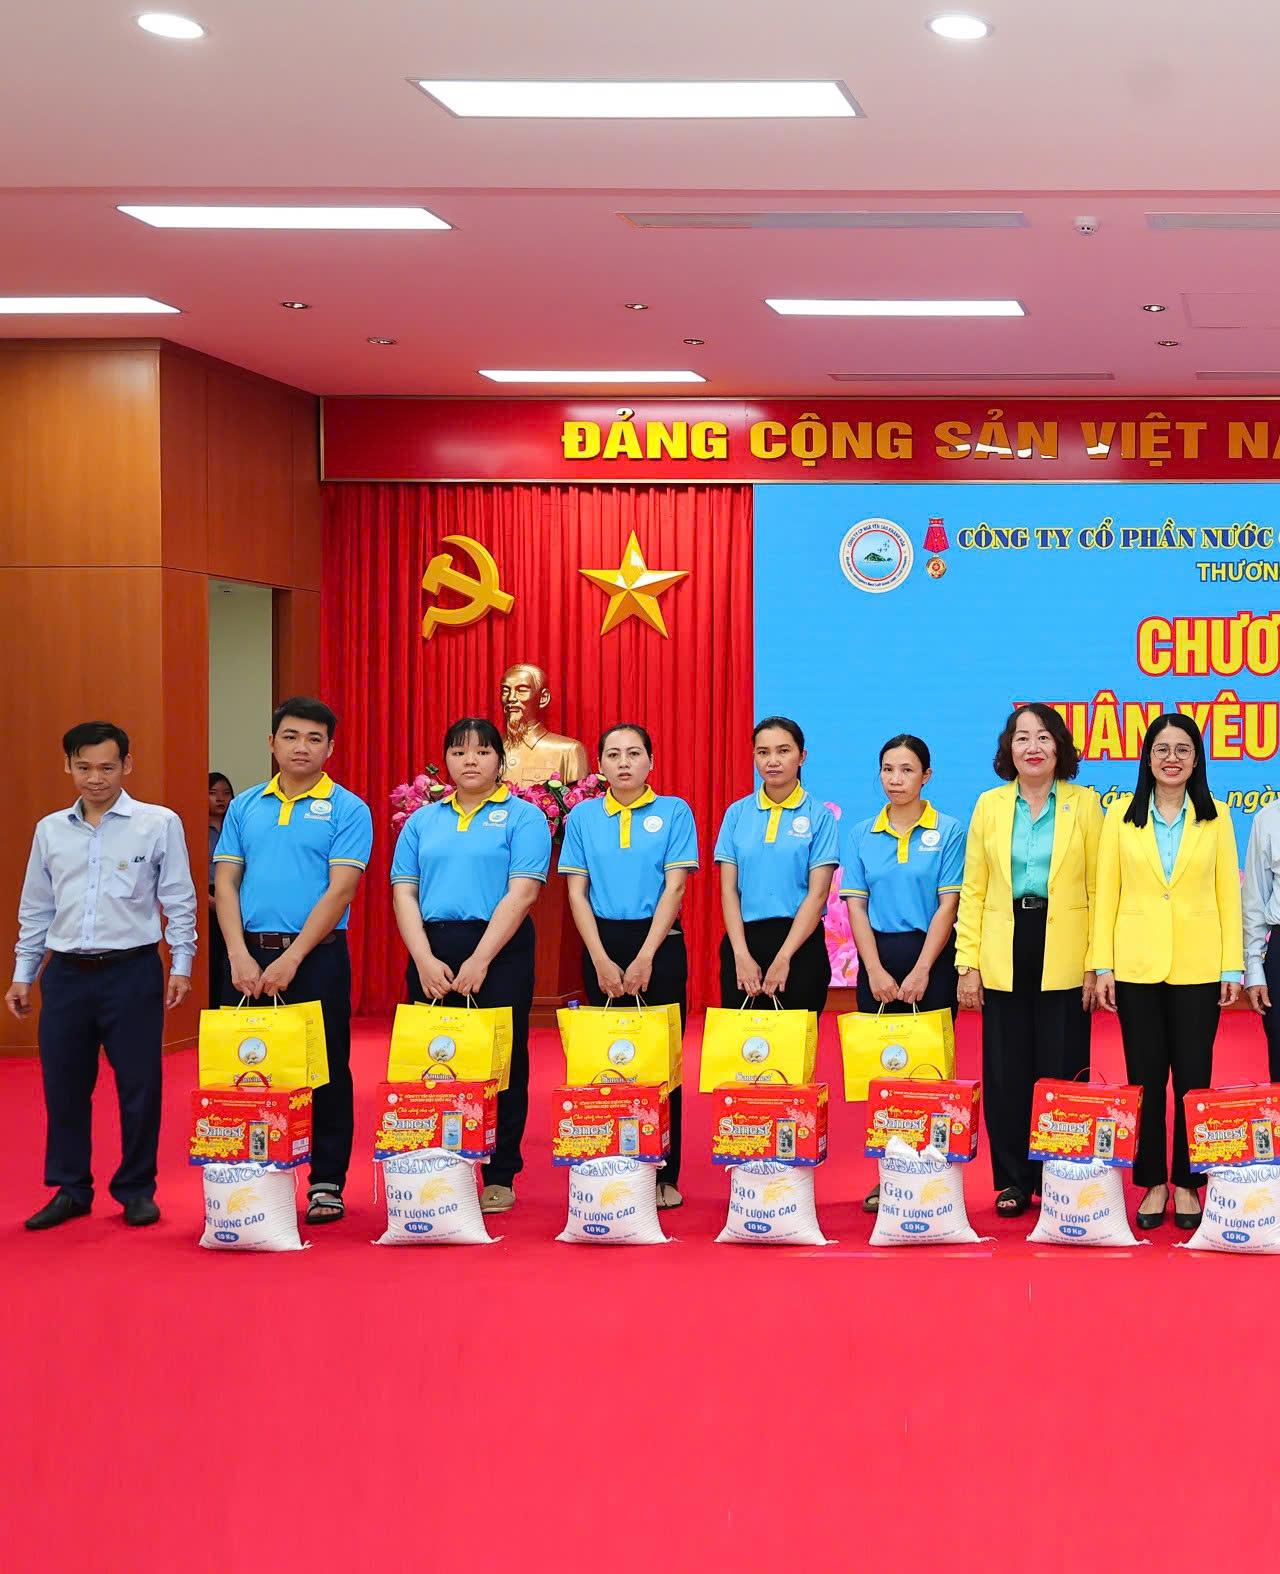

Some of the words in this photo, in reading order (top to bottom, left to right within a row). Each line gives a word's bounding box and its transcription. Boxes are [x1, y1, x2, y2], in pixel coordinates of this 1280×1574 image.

[561, 407, 728, 460] ĐẢNG
[750, 412, 913, 467] CỘNG
[934, 409, 1058, 460] SẢN
[1081, 412, 1208, 467] VIỆT
[957, 523, 1029, 549] CÔNG
[1035, 528, 1070, 549] TY
[1078, 518, 1114, 549] CỔ
[1120, 519, 1196, 549] PHẦN
[1201, 519, 1274, 549] NƯỚC
[1014, 689, 1164, 761] UÂN
[196, 1116, 246, 1139] Sanest
[382, 1109, 438, 1130] Sanest
[559, 1116, 614, 1137] Sanest
[719, 1115, 773, 1136] Sanest
[874, 1108, 927, 1131] Sanest
[1039, 1111, 1093, 1134] Sanest
[1194, 1121, 1248, 1143] Sanest
[387, 1185, 412, 1203] Gạo
[570, 1183, 593, 1204] Gạo
[884, 1182, 913, 1200] Gạo
[1044, 1183, 1069, 1204] Gạo
[1210, 1187, 1236, 1209] Gạo
[214, 1219, 241, 1230] LƯỢNG
[244, 1213, 265, 1225] CAO
[405, 1208, 435, 1220] LƯỢNG
[438, 1204, 458, 1215] CAO
[584, 1212, 613, 1223] LƯỢNG
[616, 1207, 635, 1218] CAO
[746, 1209, 775, 1221] LƯỢNG
[779, 1204, 797, 1216] CAO
[903, 1210, 933, 1221] LƯỢNG
[936, 1204, 952, 1215] CAO
[1061, 1213, 1090, 1225] LƯỢNG
[1093, 1208, 1109, 1220] CAO
[1225, 1218, 1255, 1230] LƯỢNG
[1258, 1216, 1275, 1226] CAO
